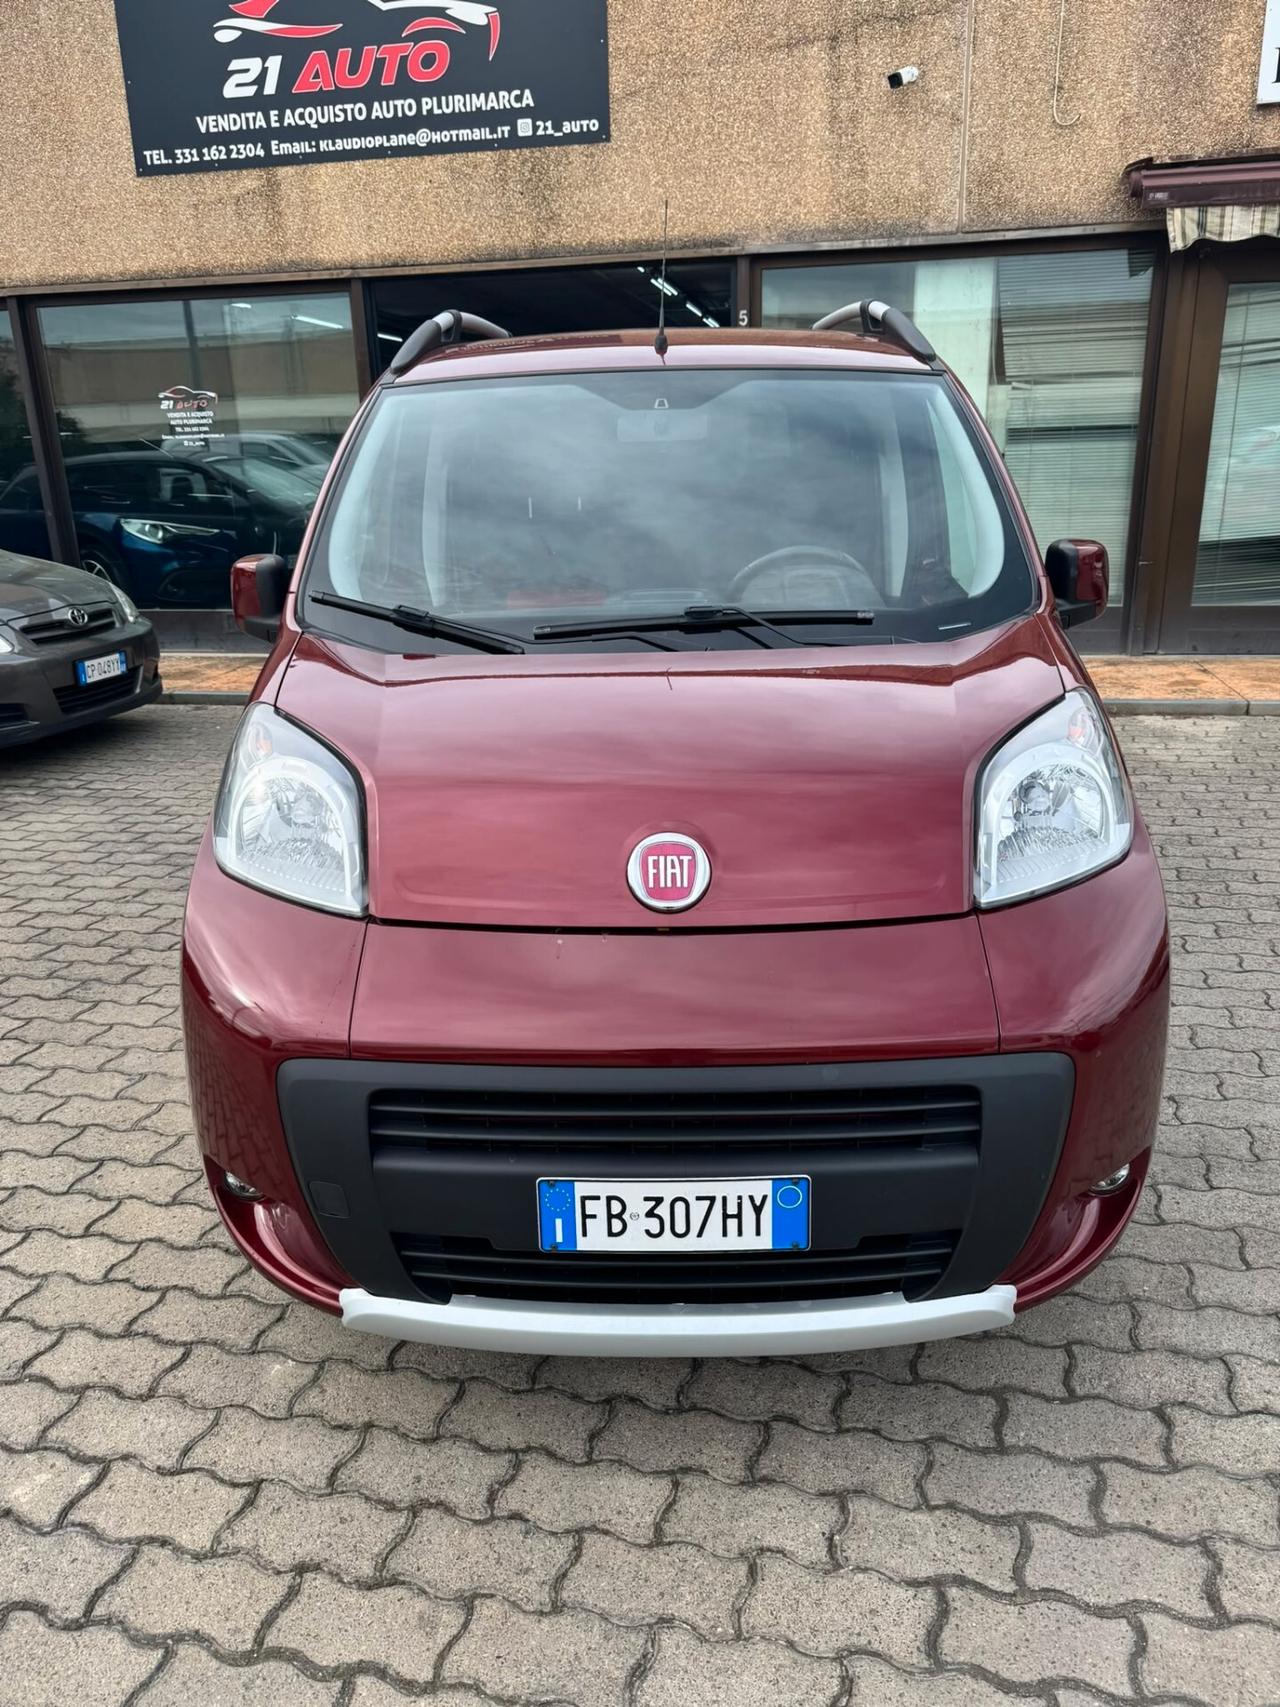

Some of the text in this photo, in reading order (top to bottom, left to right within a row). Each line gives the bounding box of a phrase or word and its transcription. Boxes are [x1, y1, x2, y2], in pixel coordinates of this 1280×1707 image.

[222, 39, 451, 99] 21 AUTO
[195, 88, 535, 134] VENDITA E ACQUISTO AUTO PLURIMARCA
[143, 150, 173, 166] TEL.
[175, 148, 200, 164] 331
[202, 145, 228, 160] 162
[230, 142, 265, 159] 2304
[738, 309, 749, 327] 5
[160, 400, 174, 409] 21
[647, 855, 692, 888] FIAT
[579, 1194, 628, 1238] FB
[643, 1193, 769, 1239] 307HY
